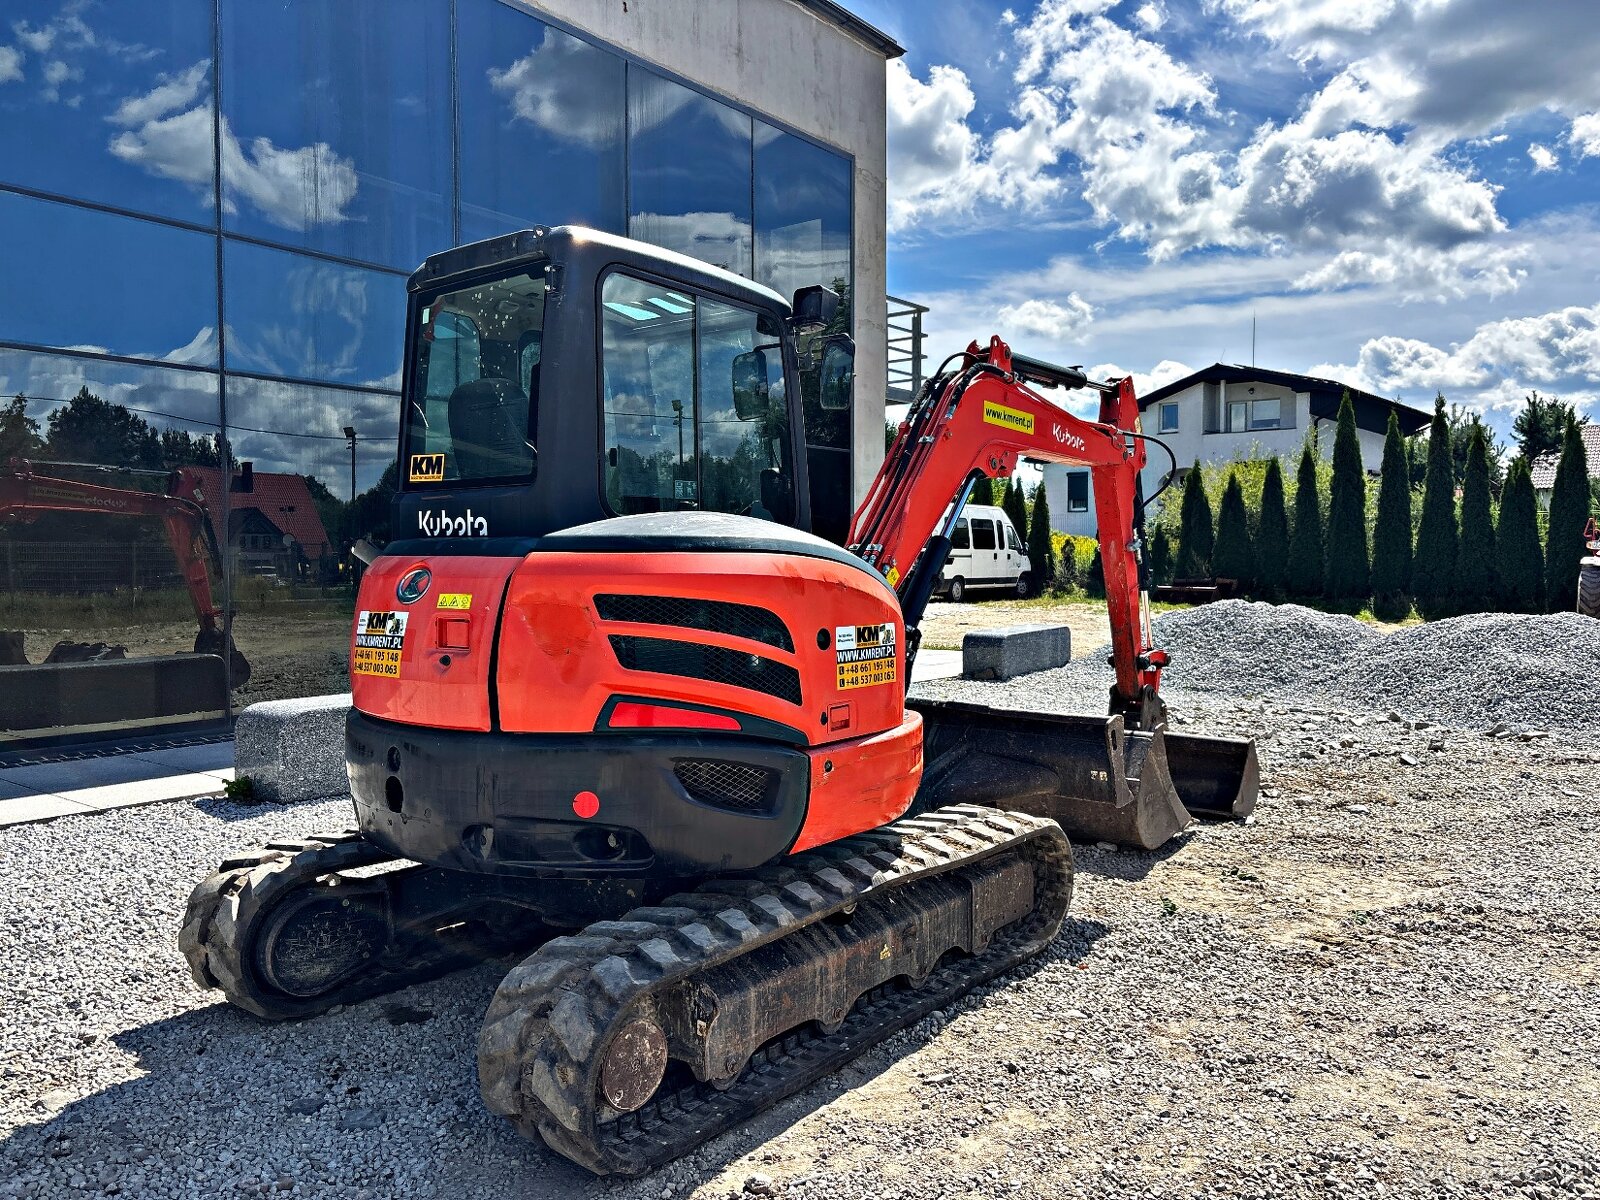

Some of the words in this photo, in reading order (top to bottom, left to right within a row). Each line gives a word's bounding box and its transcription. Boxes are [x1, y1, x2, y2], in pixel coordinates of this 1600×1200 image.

[985, 407, 1033, 430] www.kmrent.pl
[1052, 422, 1085, 451] Kubota
[412, 456, 443, 475] KM
[418, 509, 488, 536] Kubota
[367, 613, 388, 629] KM
[355, 635, 402, 649] WWW.KMRENT.PL
[857, 626, 879, 643] KM
[375, 651, 385, 661] 195
[387, 652, 399, 662] 148
[837, 646, 895, 662] WWW.KMRENT.PL
[373, 663, 383, 673] 003
[385, 664, 397, 675] 063
[846, 664, 858, 674] +48
[860, 663, 872, 673] 661
[846, 676, 859, 686] +48
[860, 674, 872, 684] 537
